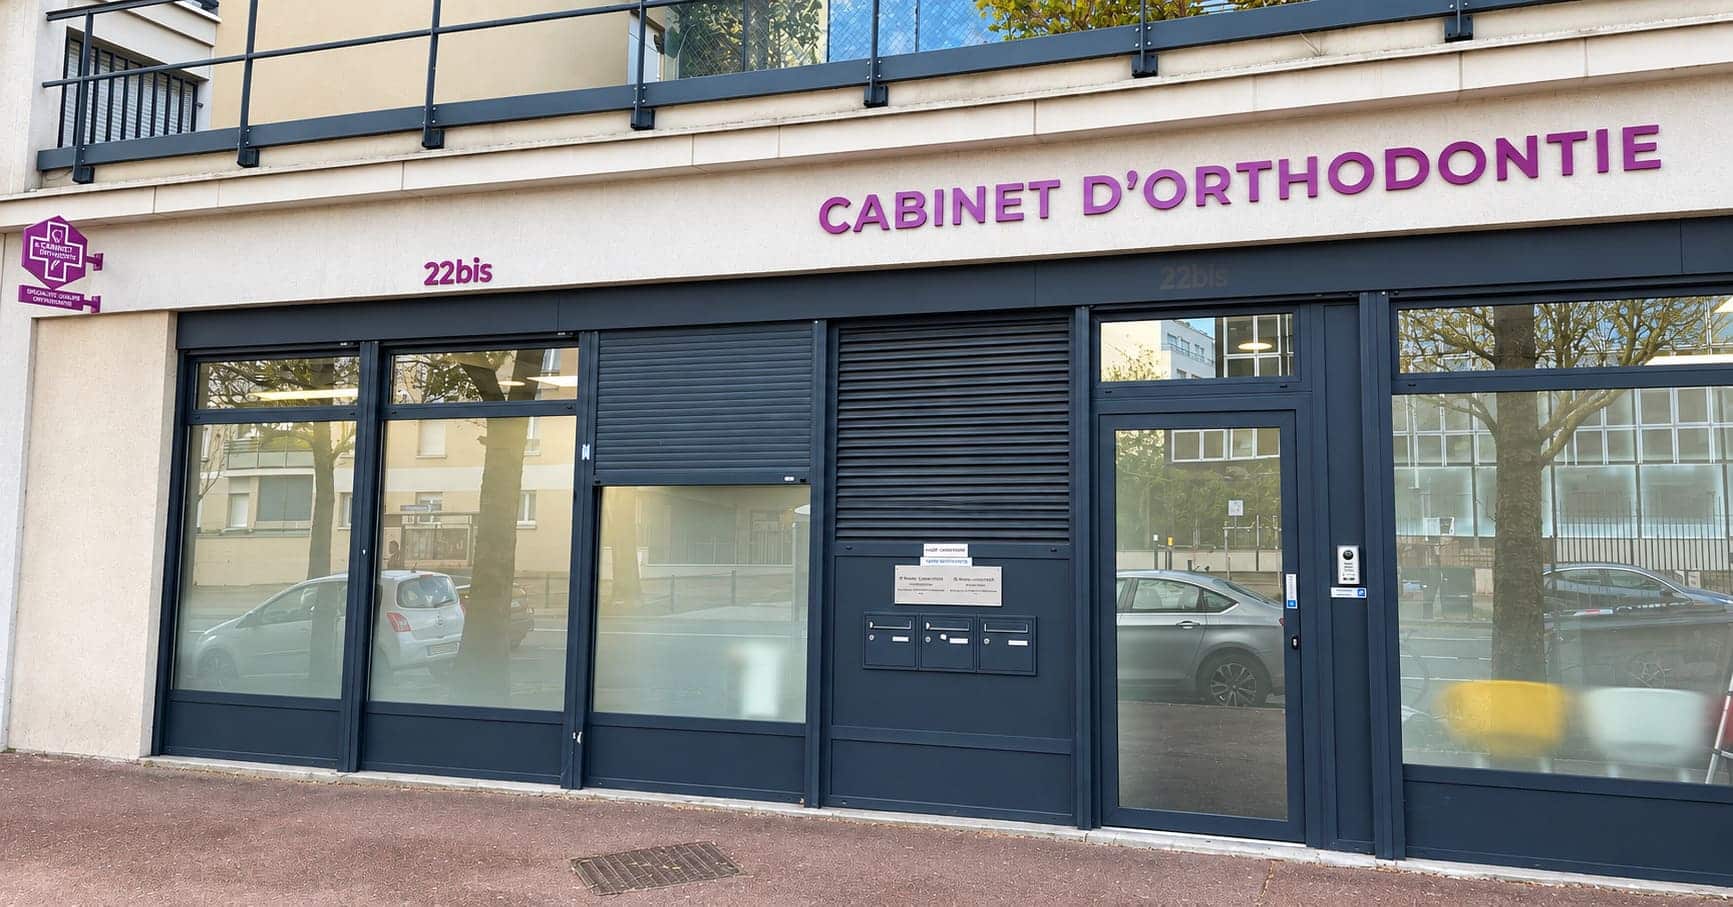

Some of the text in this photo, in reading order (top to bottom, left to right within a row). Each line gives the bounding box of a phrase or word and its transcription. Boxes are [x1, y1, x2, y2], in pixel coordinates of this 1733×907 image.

[819, 124, 1662, 234] CABINET D'ORTHODONTIE
[424, 257, 493, 285] 22bis
[1160, 264, 1229, 289] 22bis
